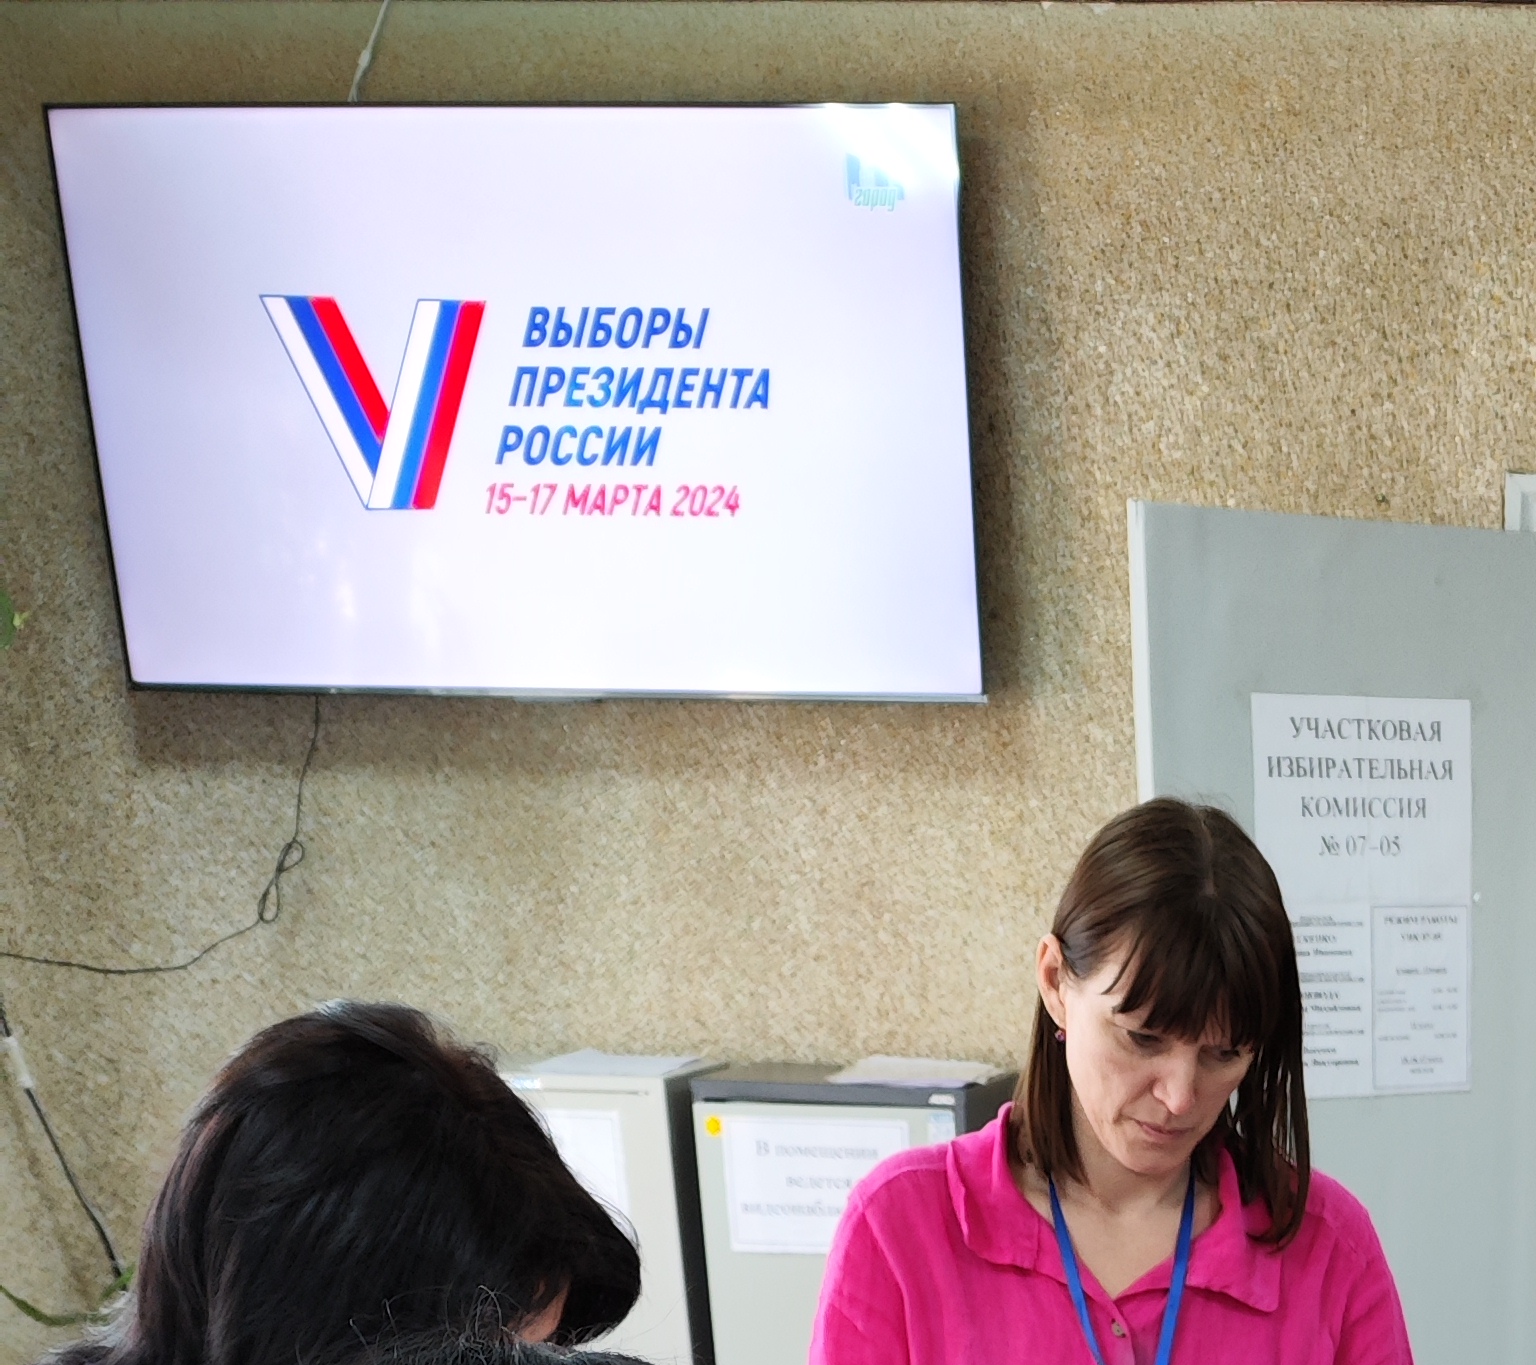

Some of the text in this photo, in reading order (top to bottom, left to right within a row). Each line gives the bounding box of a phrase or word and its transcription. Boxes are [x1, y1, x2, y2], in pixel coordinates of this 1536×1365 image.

[522, 306, 711, 350] ВЫБОРЫ
[508, 366, 770, 415] ПРЕЗИДЕНТА
[494, 425, 663, 467] РОССИИ
[562, 483, 662, 517] МАРТА
[670, 484, 741, 518] 2024
[1289, 716, 1442, 743] УЧАСТКОВАЯ
[1267, 756, 1454, 781] ИЗБИРАТЕЛЬНАЯ
[1300, 796, 1428, 819] КОМИССИЯ
